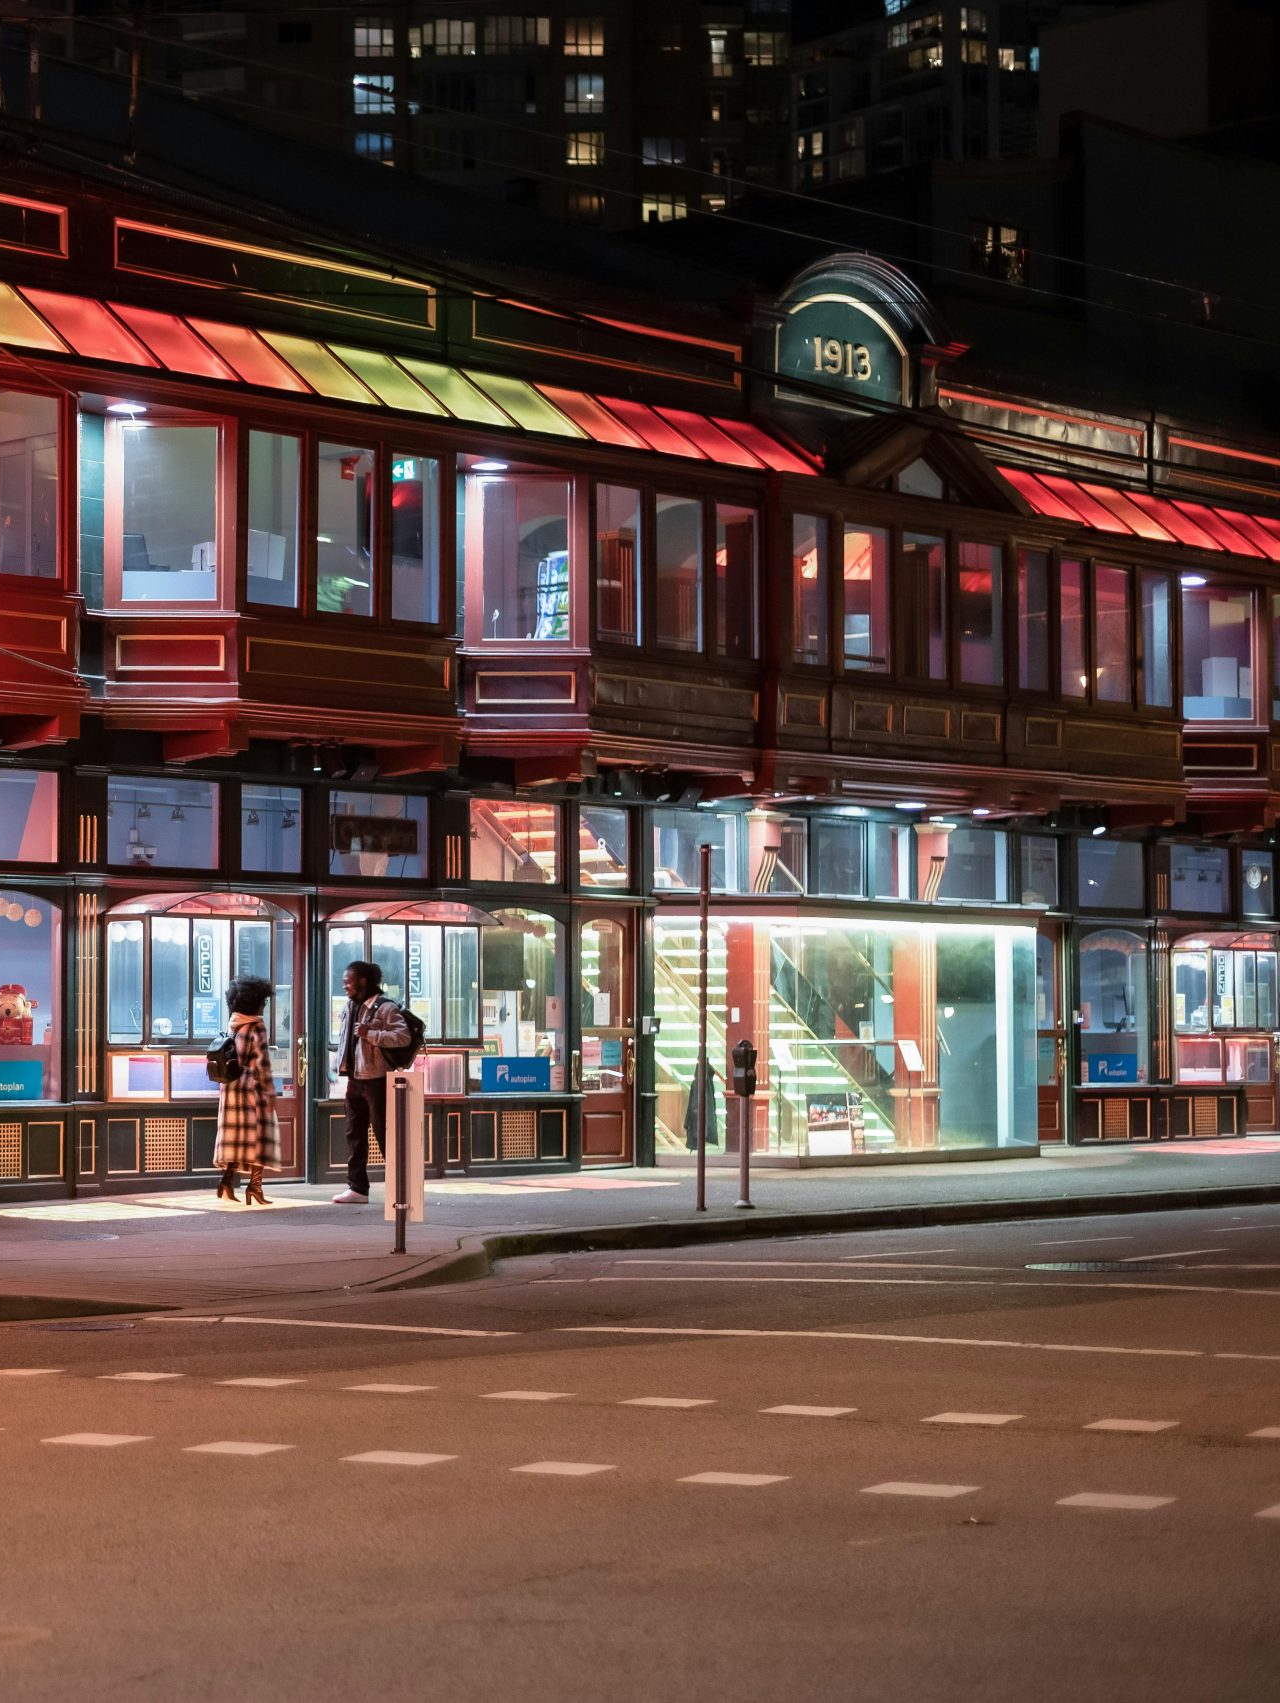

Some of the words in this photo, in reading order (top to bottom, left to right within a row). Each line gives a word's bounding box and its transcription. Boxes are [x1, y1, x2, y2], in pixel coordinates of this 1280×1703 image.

[813, 335, 873, 382] 1913
[200, 938, 210, 990] OPEN
[409, 944, 421, 993] OPEN
[510, 1075, 537, 1084] autoplan
